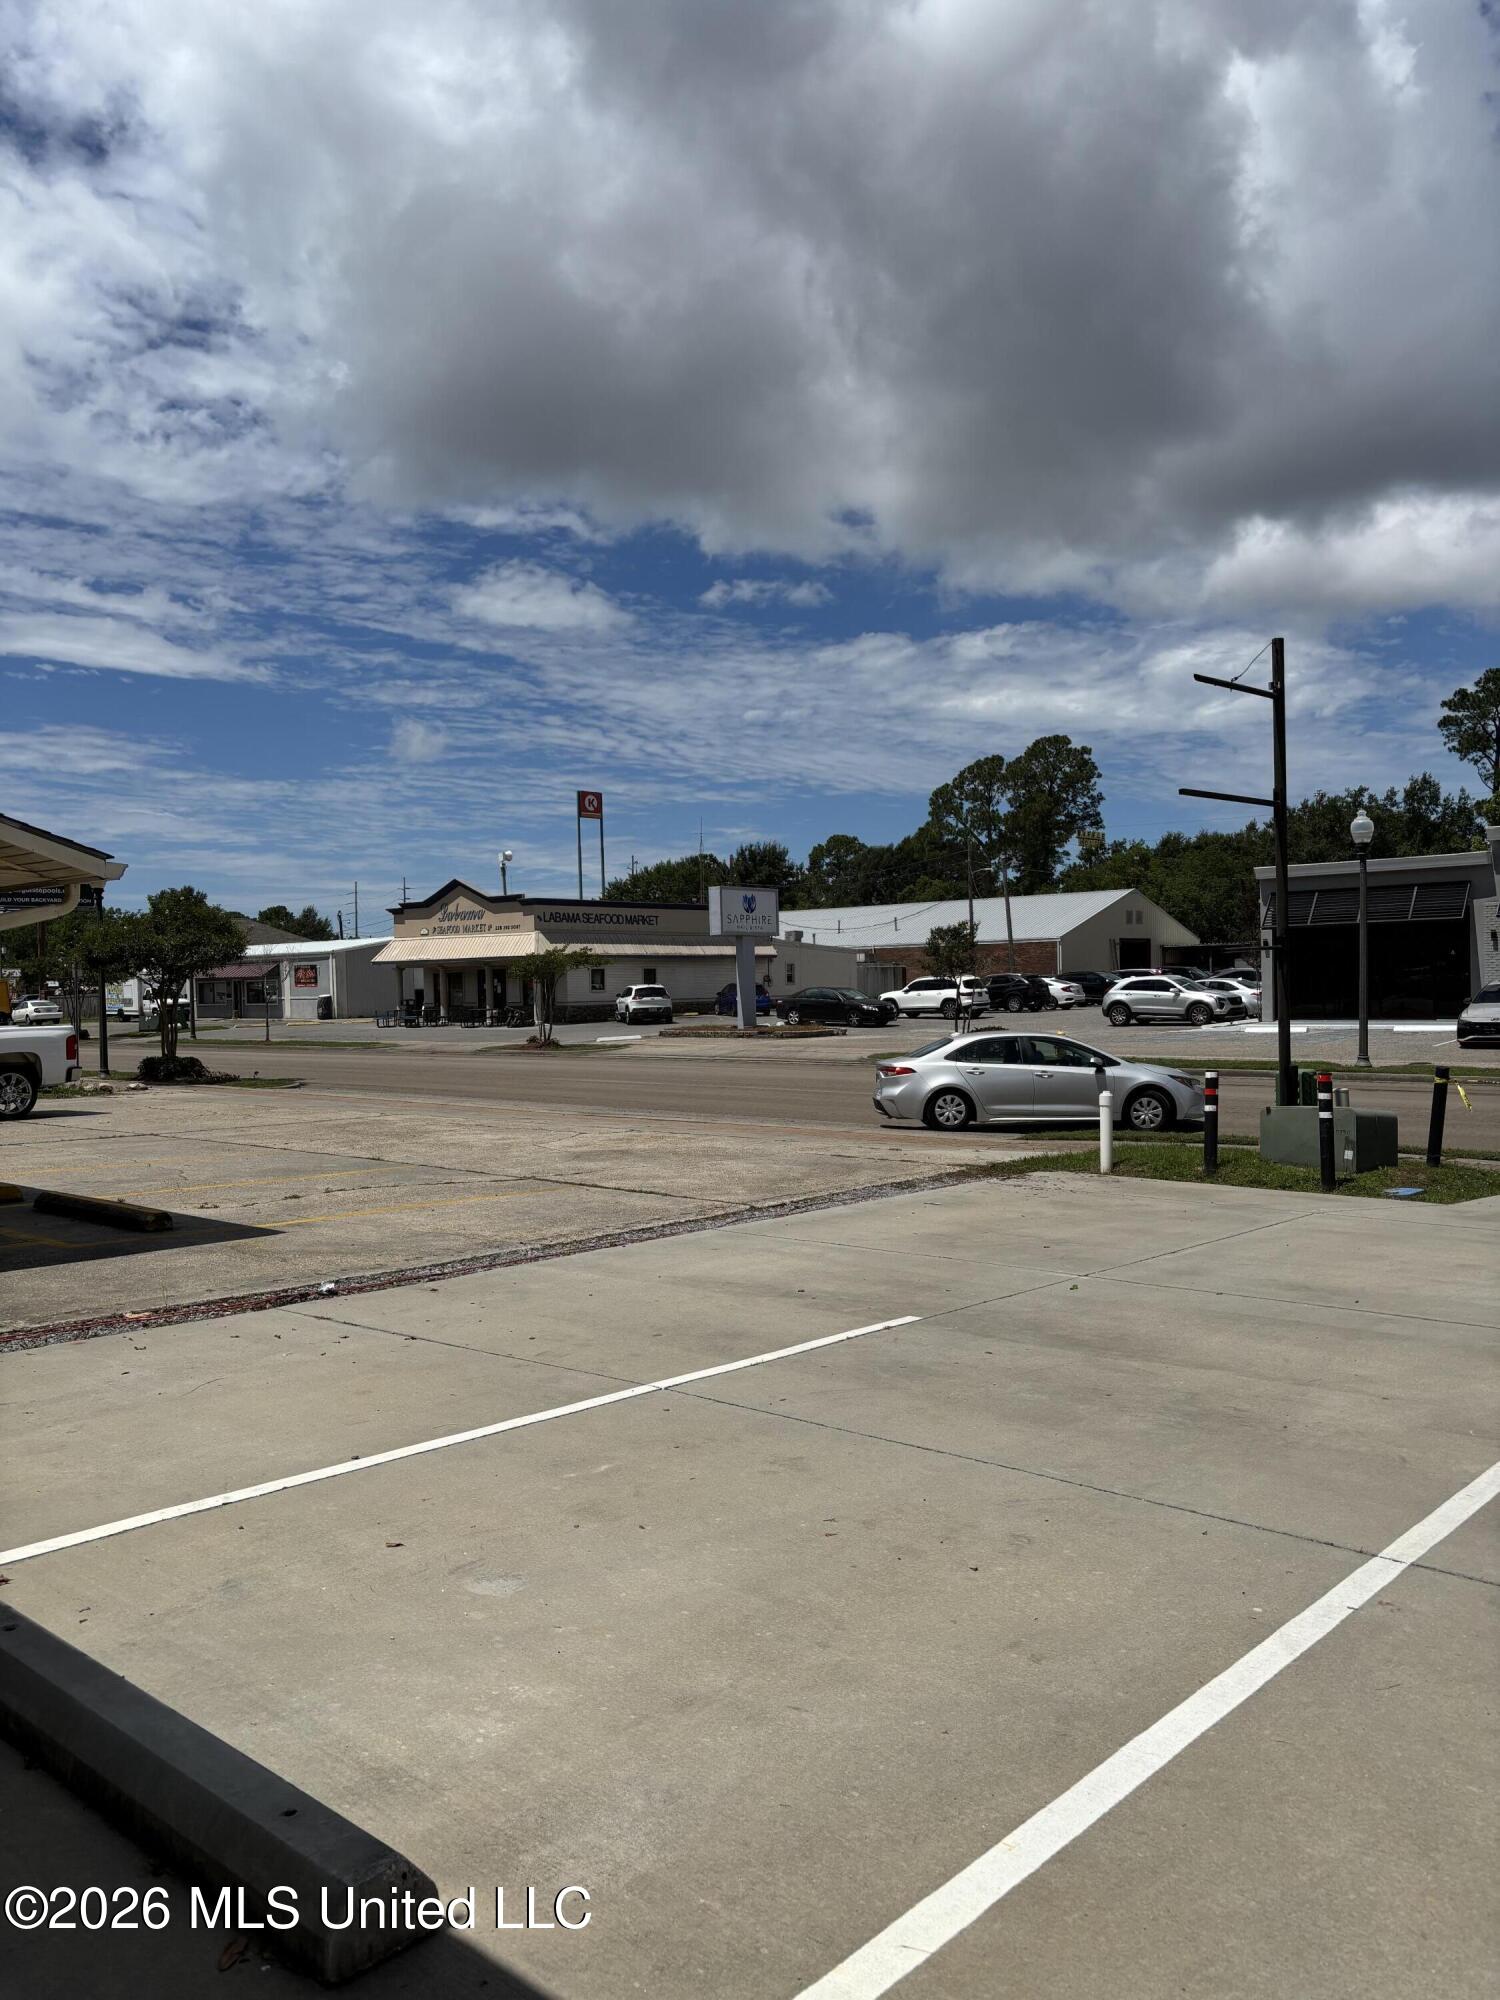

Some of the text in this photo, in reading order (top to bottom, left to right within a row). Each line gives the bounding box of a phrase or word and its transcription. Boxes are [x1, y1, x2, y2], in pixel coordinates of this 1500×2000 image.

[543, 912, 659, 925] LABAMA SEAFOOD MARKET
[727, 914, 774, 925] SAPPHIRE
[437, 925, 460, 934] SEAFOOD
[463, 924, 487, 933] MARKET
